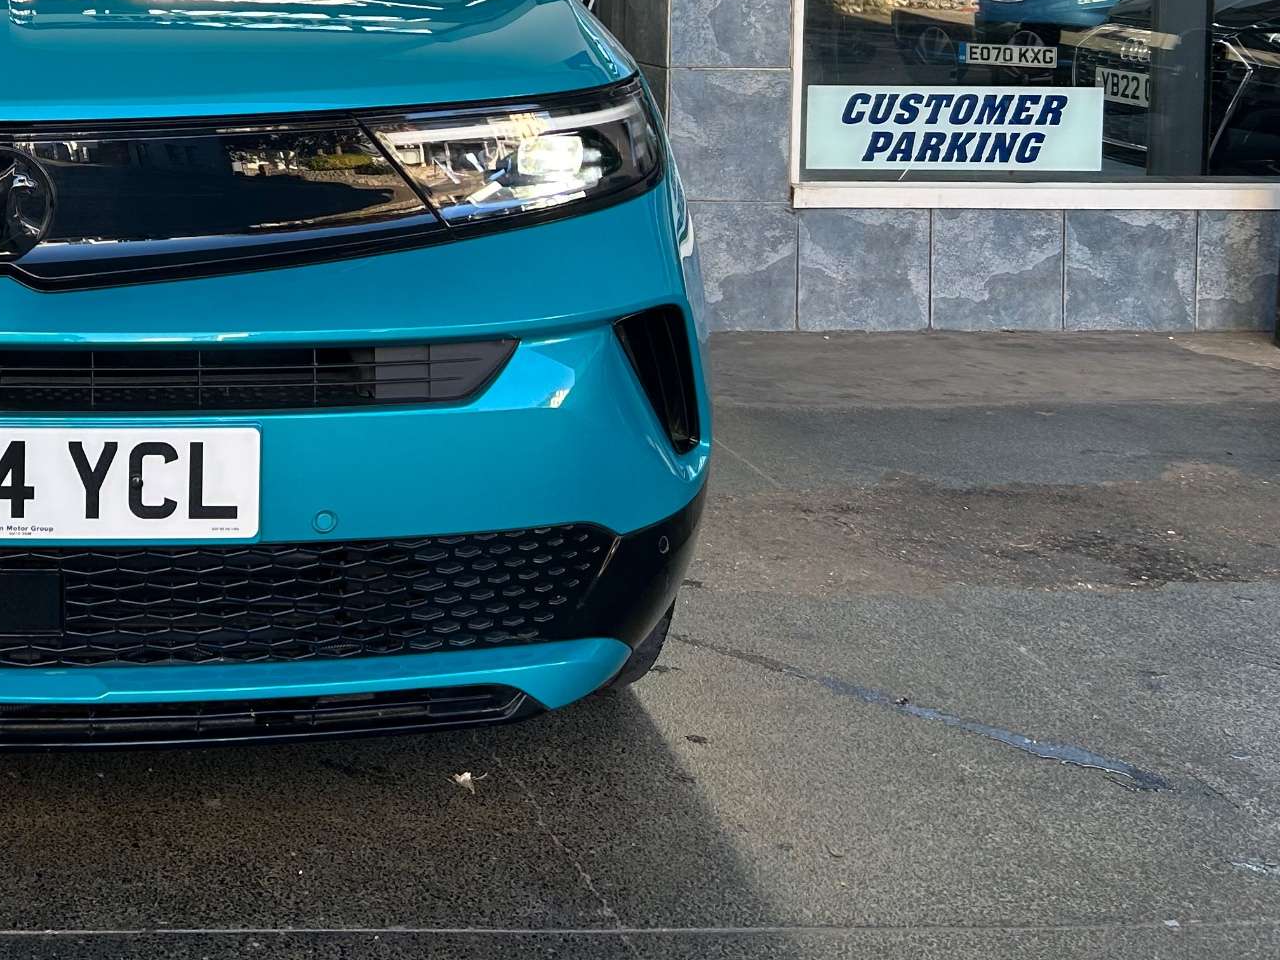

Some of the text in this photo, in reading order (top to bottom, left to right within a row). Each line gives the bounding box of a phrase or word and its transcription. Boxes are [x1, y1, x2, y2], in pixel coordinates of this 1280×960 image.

[1018, 47, 1055, 64] KXG
[1101, 71, 1140, 99] YB22
[841, 93, 1068, 126] CUSTOMER
[861, 131, 1046, 163] PARKING
[68, 441, 238, 520] YCL
[30, 525, 54, 533] Group
